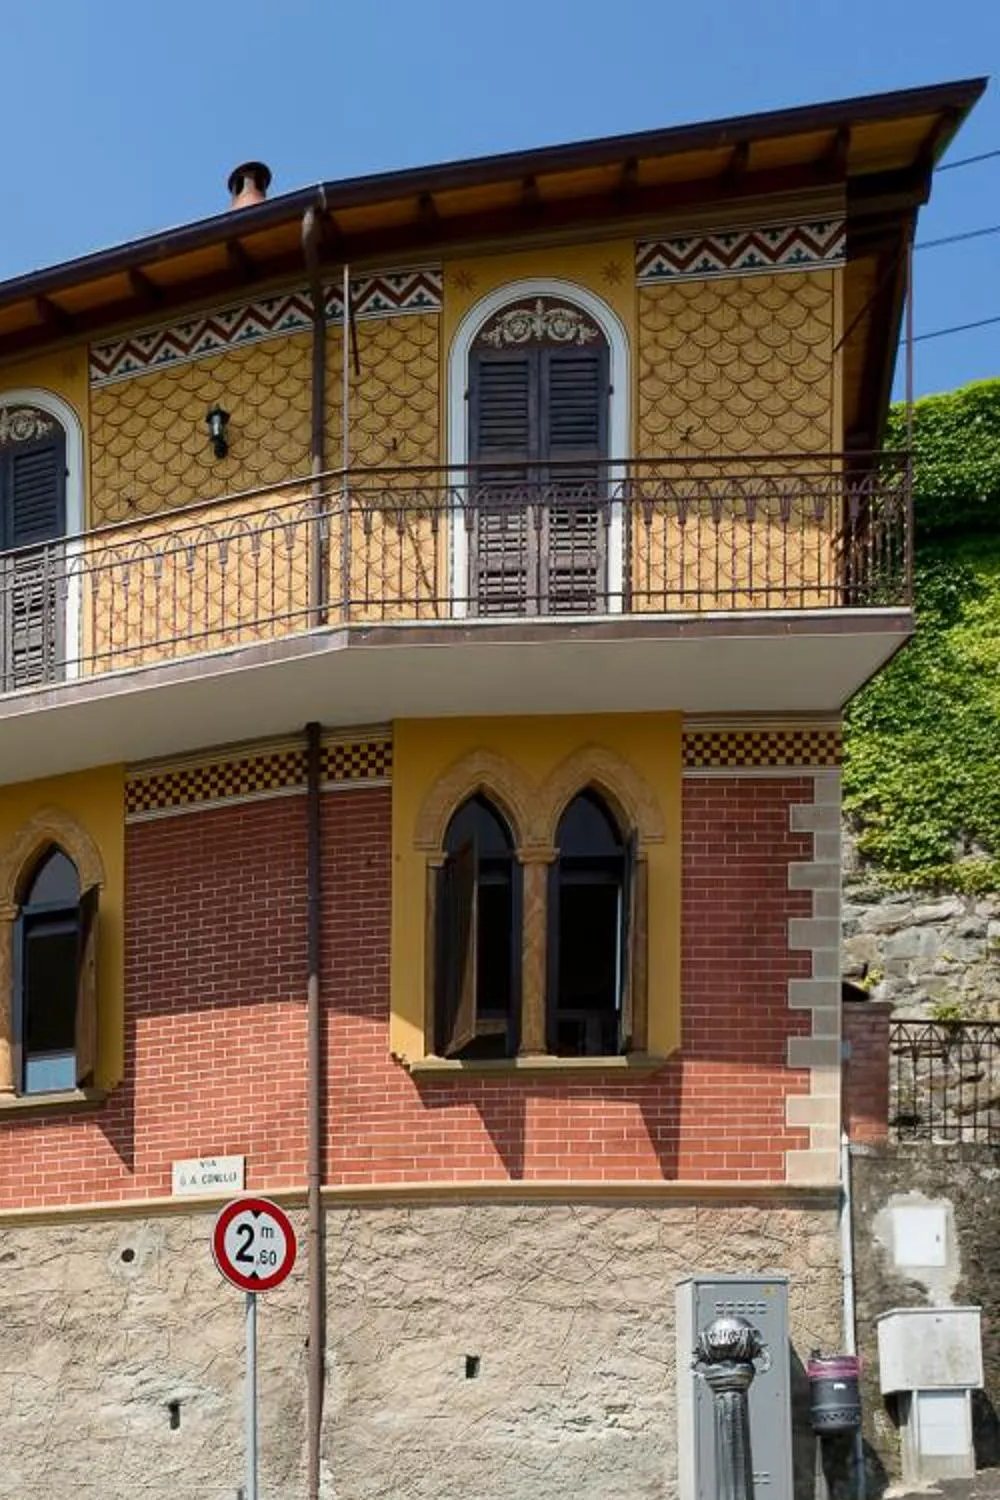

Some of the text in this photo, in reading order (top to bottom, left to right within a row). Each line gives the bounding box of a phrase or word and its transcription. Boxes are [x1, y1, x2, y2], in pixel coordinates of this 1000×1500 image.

[199, 1159, 217, 1169] VIA
[235, 1223, 275, 1263] 2 m
